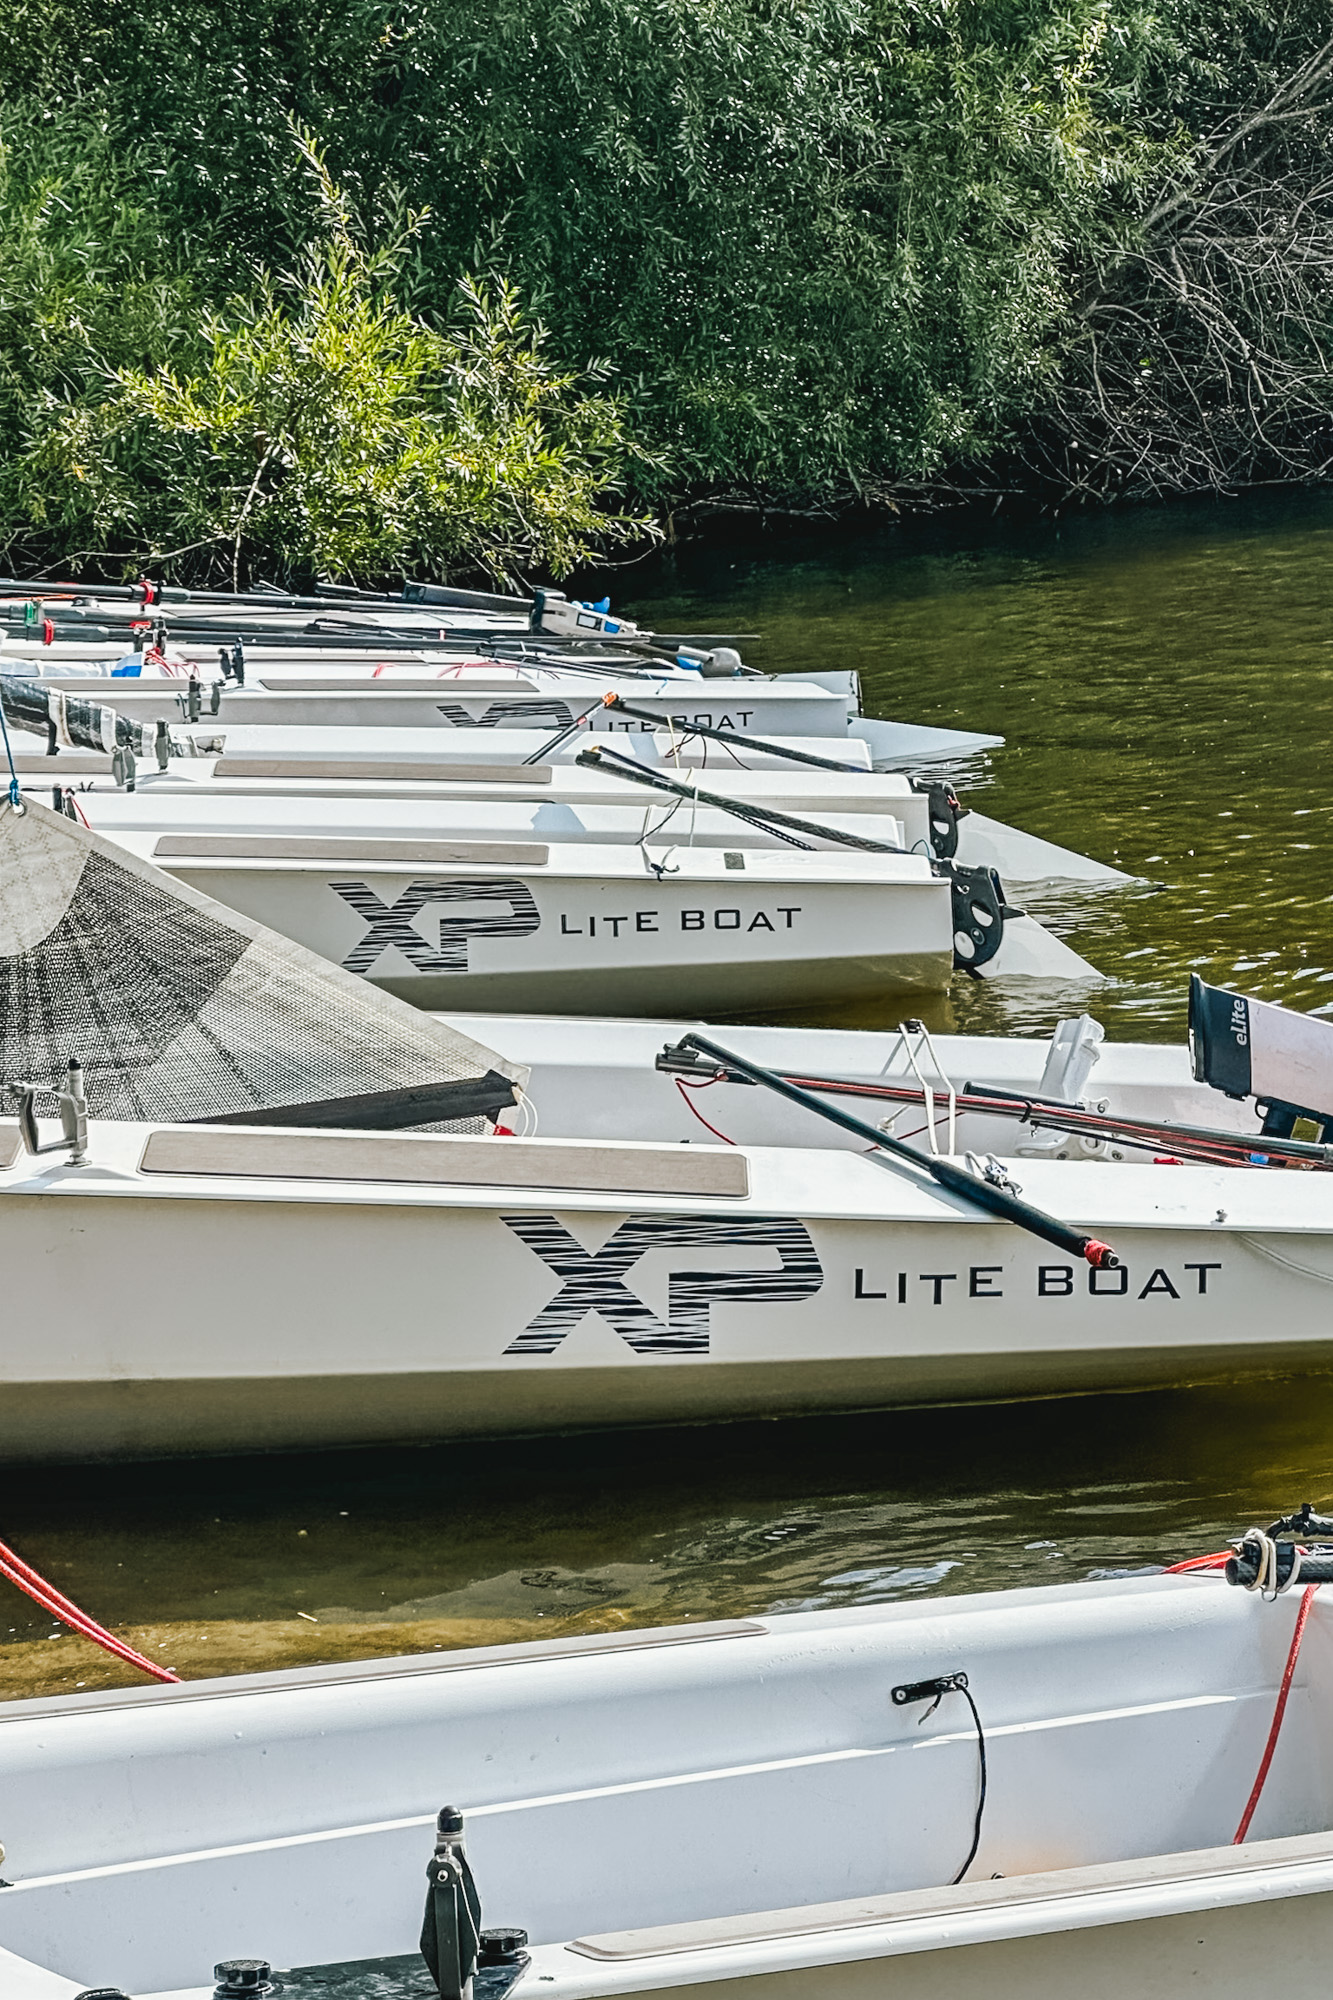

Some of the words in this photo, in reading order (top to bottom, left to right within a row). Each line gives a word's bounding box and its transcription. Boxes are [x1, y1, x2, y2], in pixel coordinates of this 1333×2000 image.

[328, 879, 541, 973] XP
[561, 911, 658, 937] LITE
[681, 908, 802, 932] BOAT
[499, 1214, 824, 1355] XP
[854, 1266, 1004, 1305] LITE
[1037, 1264, 1222, 1299] BOAT
